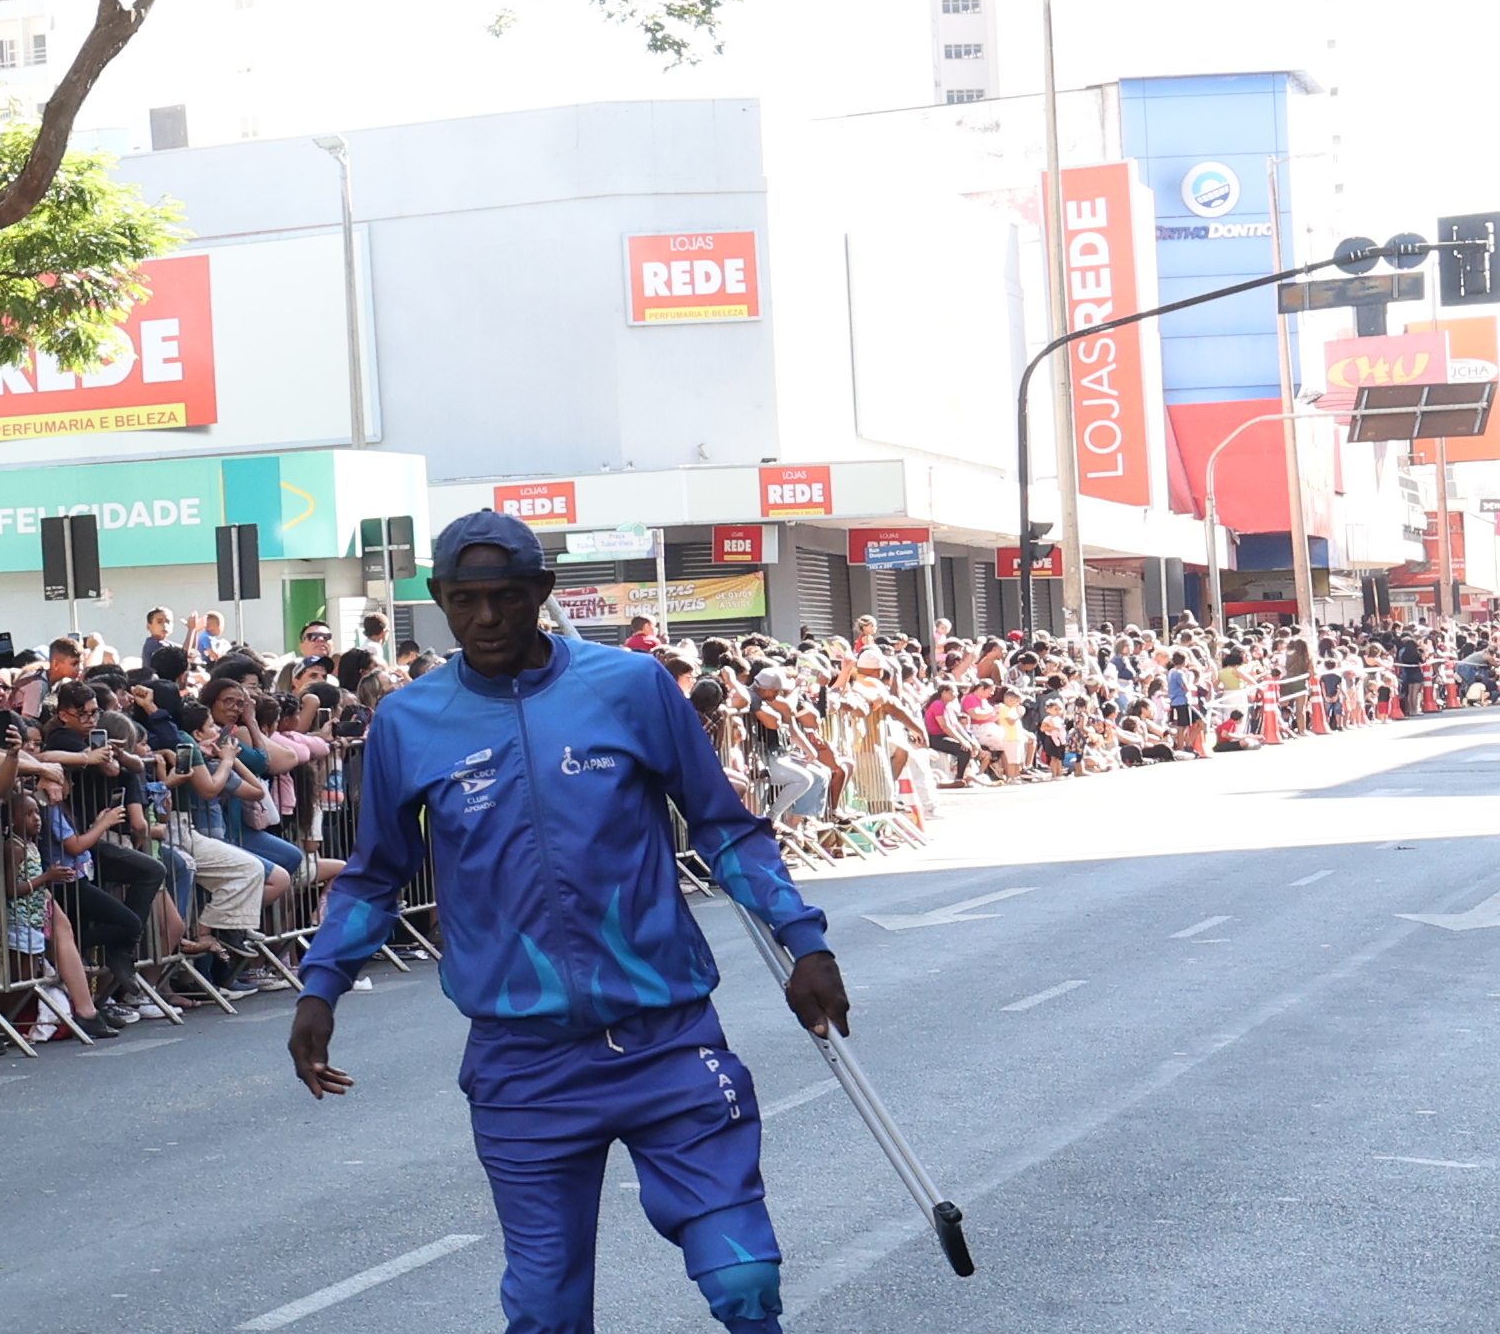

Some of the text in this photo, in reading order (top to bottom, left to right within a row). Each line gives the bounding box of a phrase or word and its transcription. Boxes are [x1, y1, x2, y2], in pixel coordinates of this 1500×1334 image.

[670, 236, 714, 251] LOJAS
[642, 258, 747, 297] REDE
[649, 310, 702, 320] PERFUMARIA
[711, 309, 744, 317] BELEZA
[99, 415, 110, 429] E
[114, 410, 179, 428] BELEZA
[782, 471, 807, 480] LOJAS
[520, 486, 549, 496] LOJAS
[767, 482, 825, 505] REDE
[503, 496, 568, 517] REDE
[723, 539, 752, 553] REDE
[628, 583, 696, 602] OFETAS
[582, 756, 616, 771] APARU
[698, 1046, 741, 1120] APARU
